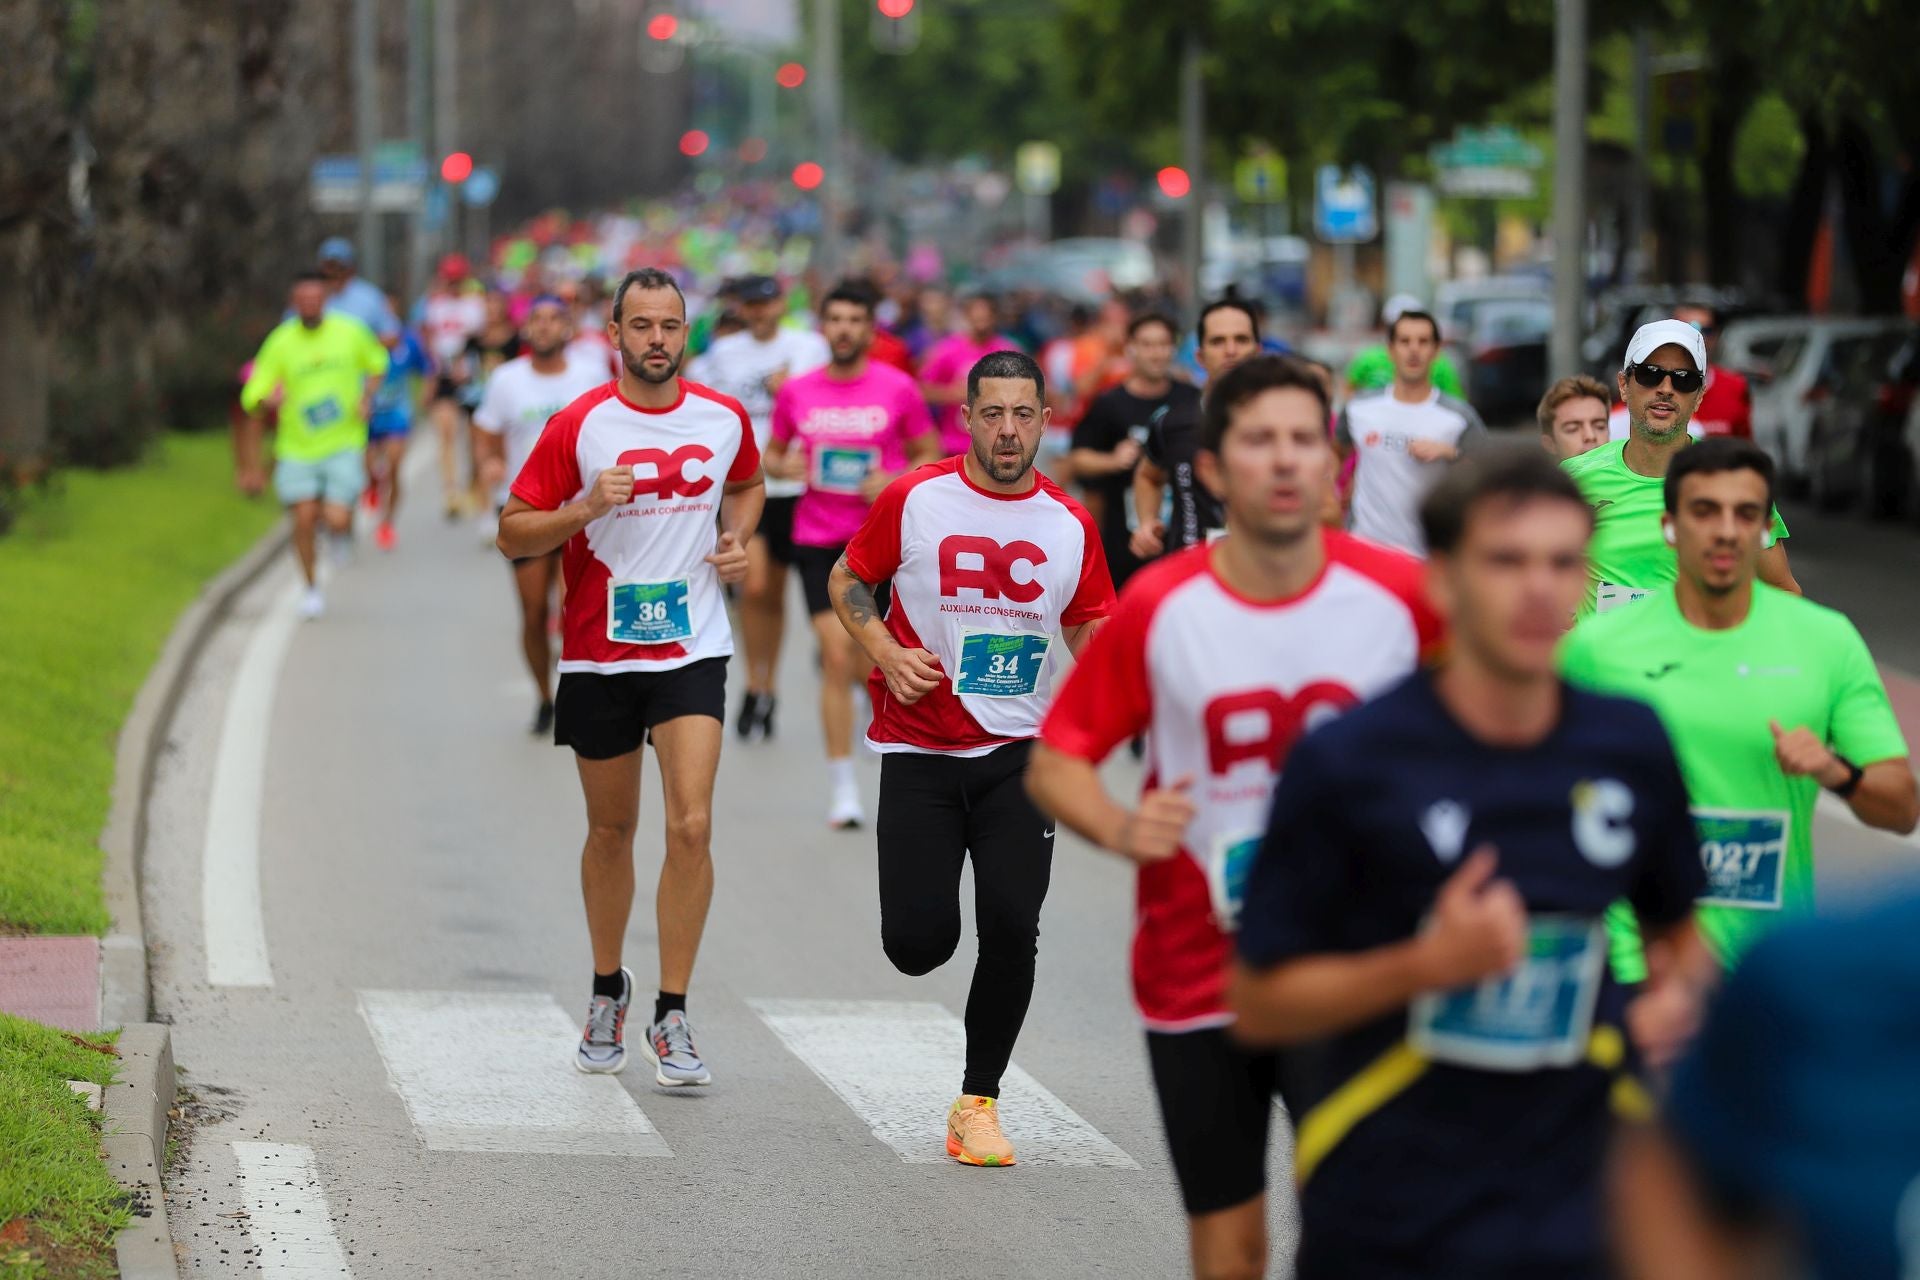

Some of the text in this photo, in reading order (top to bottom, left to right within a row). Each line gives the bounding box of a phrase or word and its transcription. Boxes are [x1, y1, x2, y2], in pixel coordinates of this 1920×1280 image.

[938, 534, 1049, 604] AC
[638, 600, 667, 622] 36
[940, 604, 981, 614] AUXILIAR
[989, 654, 1019, 675] 34
[1699, 840, 1764, 879] 027
